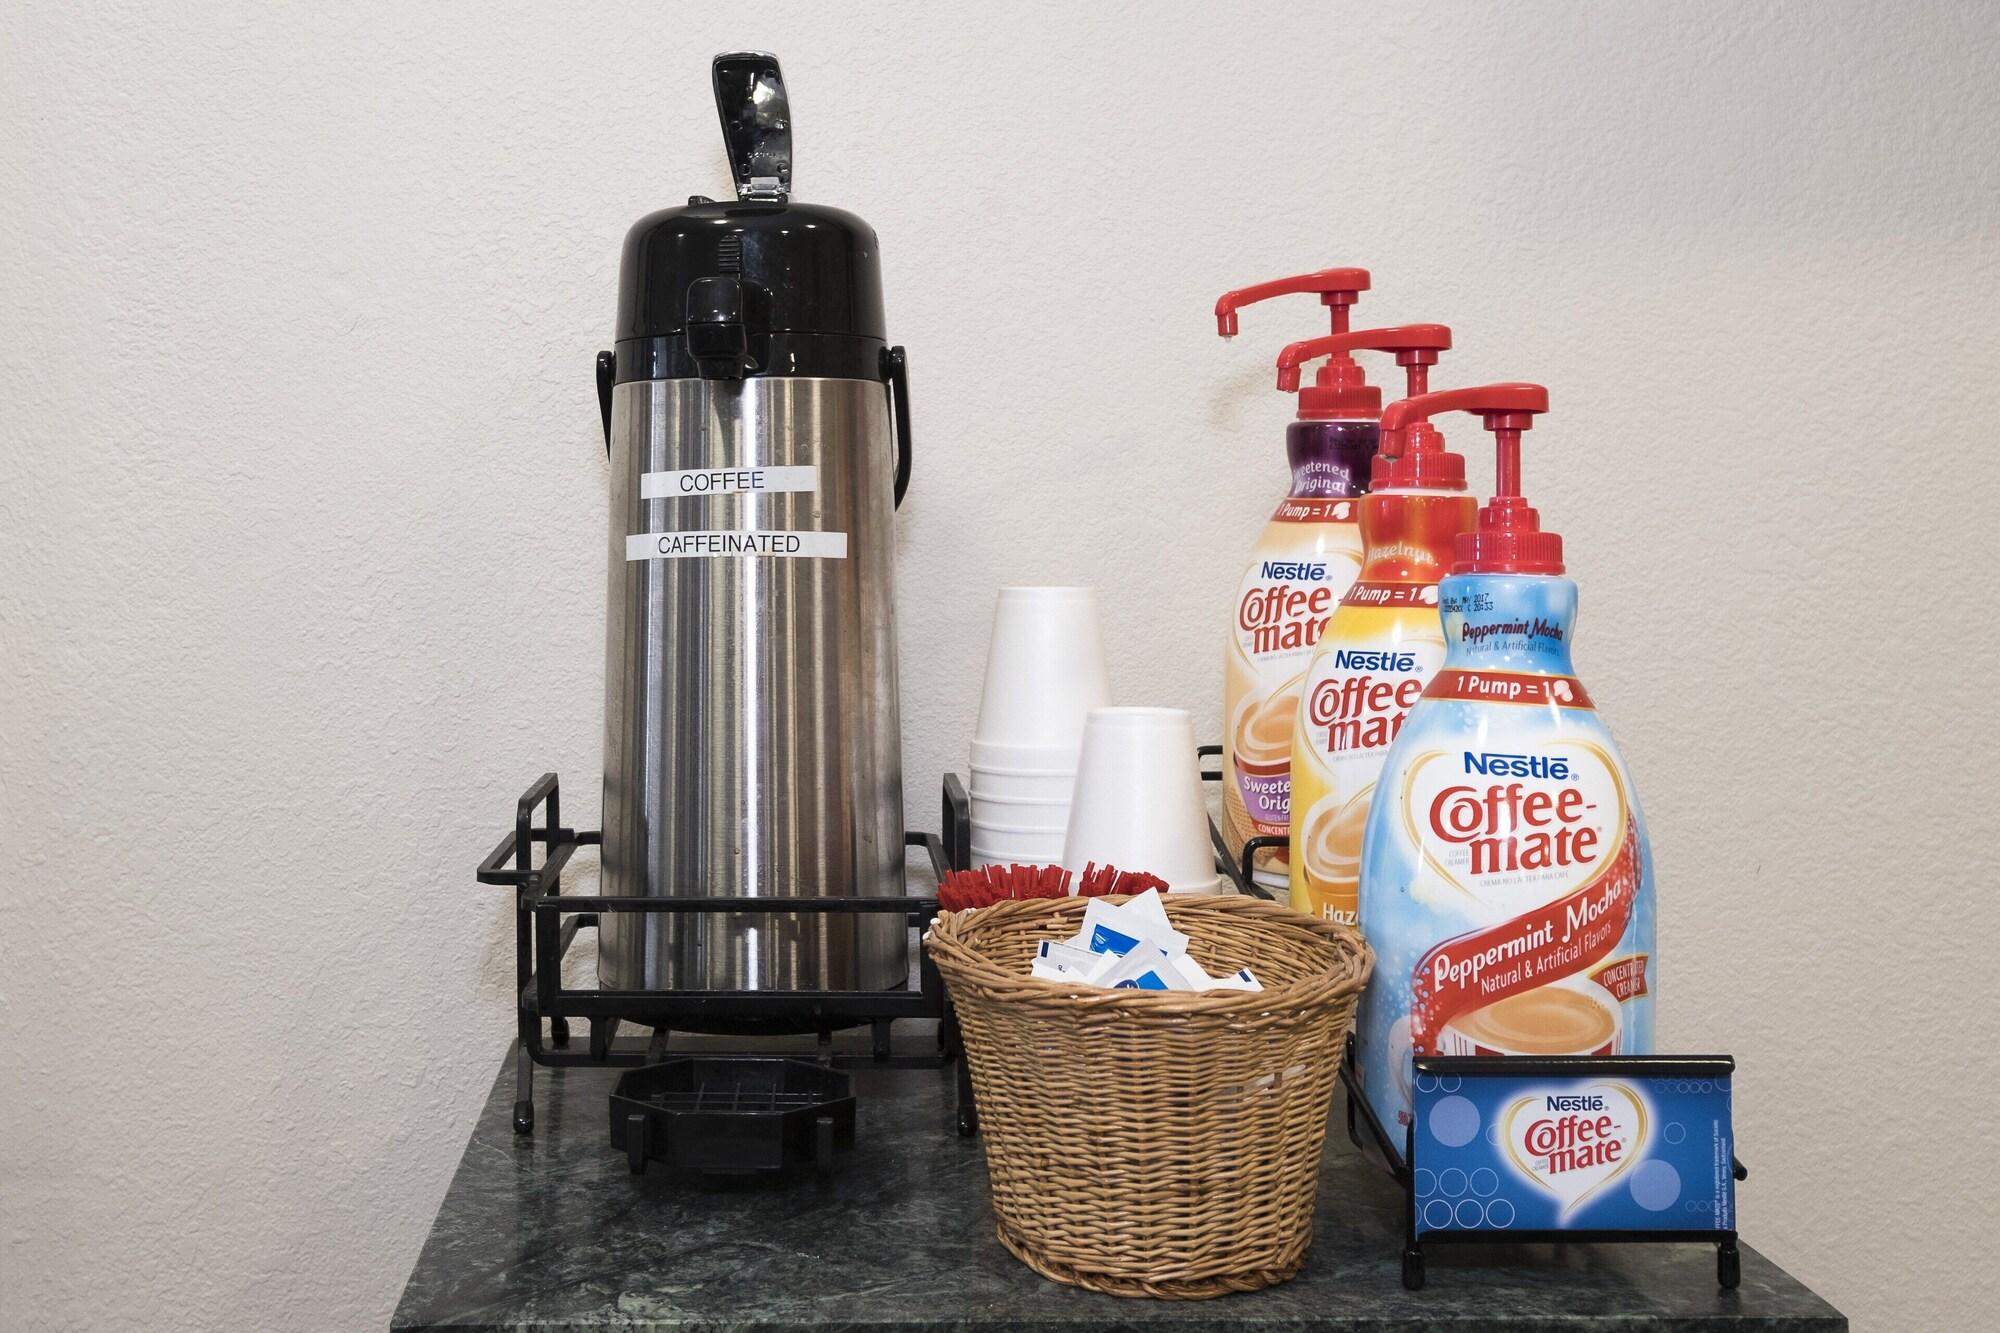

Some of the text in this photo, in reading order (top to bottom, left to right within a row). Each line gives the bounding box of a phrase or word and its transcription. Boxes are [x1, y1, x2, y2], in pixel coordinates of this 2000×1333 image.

[680, 471, 765, 492] COFFEE
[1293, 461, 1350, 482] eetened
[1281, 503, 1310, 520] Pump
[1324, 504, 1332, 517] 1
[658, 535, 800, 554] CAFFEINATED
[1261, 561, 1327, 580] Nestlé
[1354, 586, 1391, 604] Pump
[1409, 587, 1418, 601] 1
[1462, 617, 1564, 644] Peppermint Mocha
[1466, 642, 1492, 656] Natural
[1501, 640, 1536, 652] Artificial
[1335, 650, 1416, 672] Nestlé
[1457, 675, 1465, 692] 1
[1468, 675, 1521, 699] Pump
[1543, 681, 1550, 697] 1
[1464, 752, 1569, 780] Nestlé
[1259, 795, 1291, 814] Orig
[1429, 783, 1597, 843] Coffee-
[1469, 827, 1598, 875] mate
[1323, 901, 1358, 925] Haz
[1434, 880, 1622, 993] Peppermint Mocha
[1481, 920, 1612, 995] Natural & Artificial Flavors
[1547, 1096, 1603, 1111] Nestlé
[1524, 1115, 1621, 1156] Coffee-
[1549, 1140, 1622, 1174] mate
